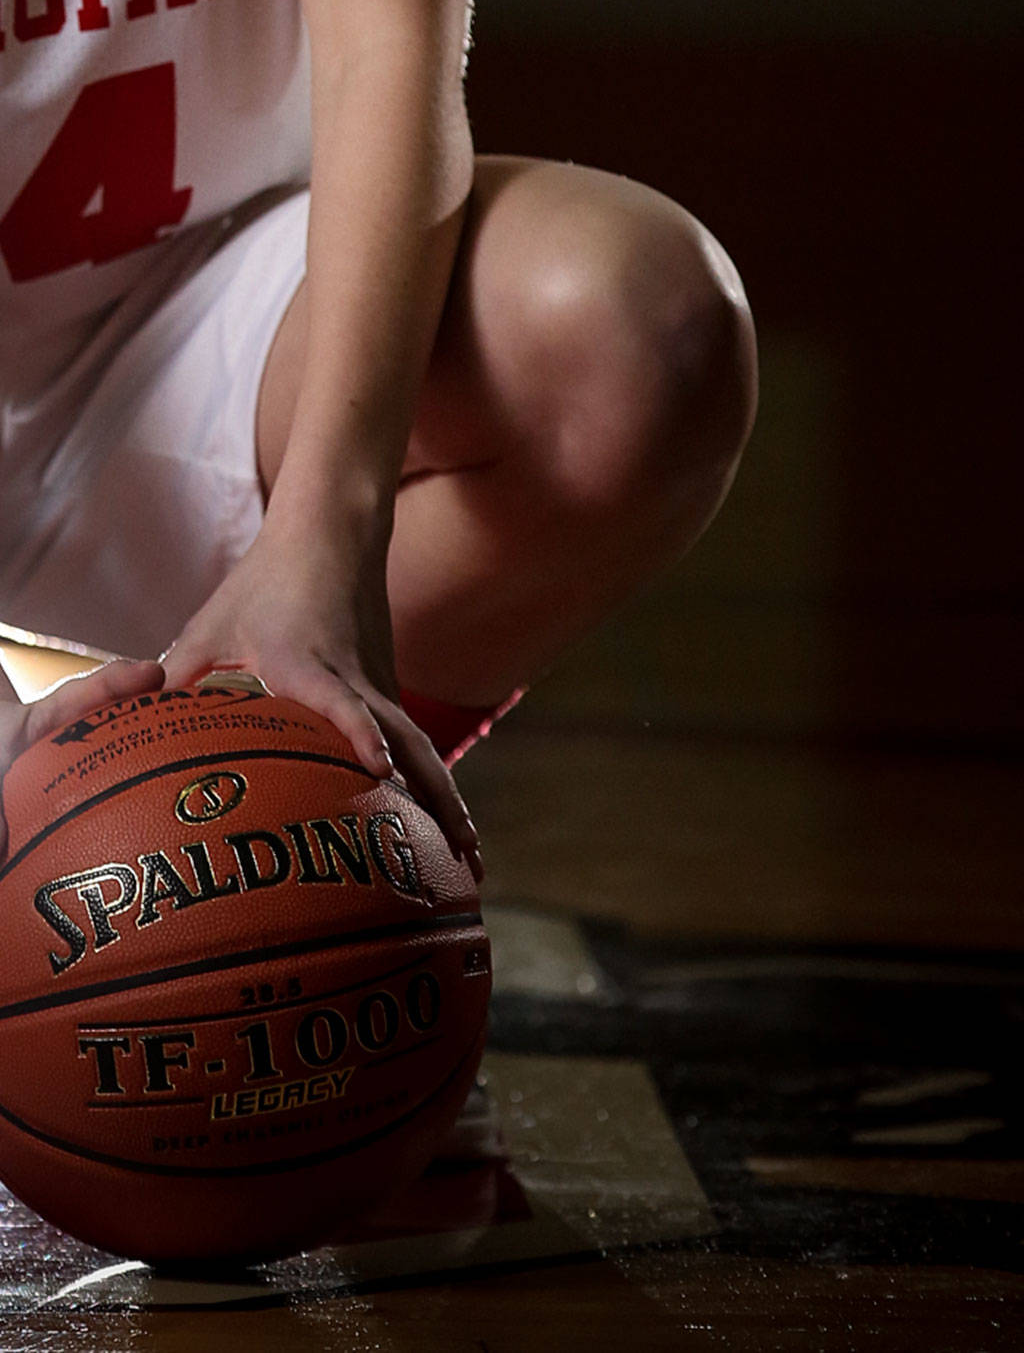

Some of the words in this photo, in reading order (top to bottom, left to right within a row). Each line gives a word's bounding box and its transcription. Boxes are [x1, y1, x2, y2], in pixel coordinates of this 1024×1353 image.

[43, 725, 152, 794] WASHINGTON
[159, 712, 319, 734] INTERSCHOLASTIC
[78, 732, 165, 780] ACTIVITIES
[171, 720, 284, 737] ASSOCIATION
[32, 812, 435, 976] SPALDING
[240, 976, 303, 1005] 28.5
[77, 971, 442, 1097] TF-1000
[210, 1067, 356, 1121] LEGACY
